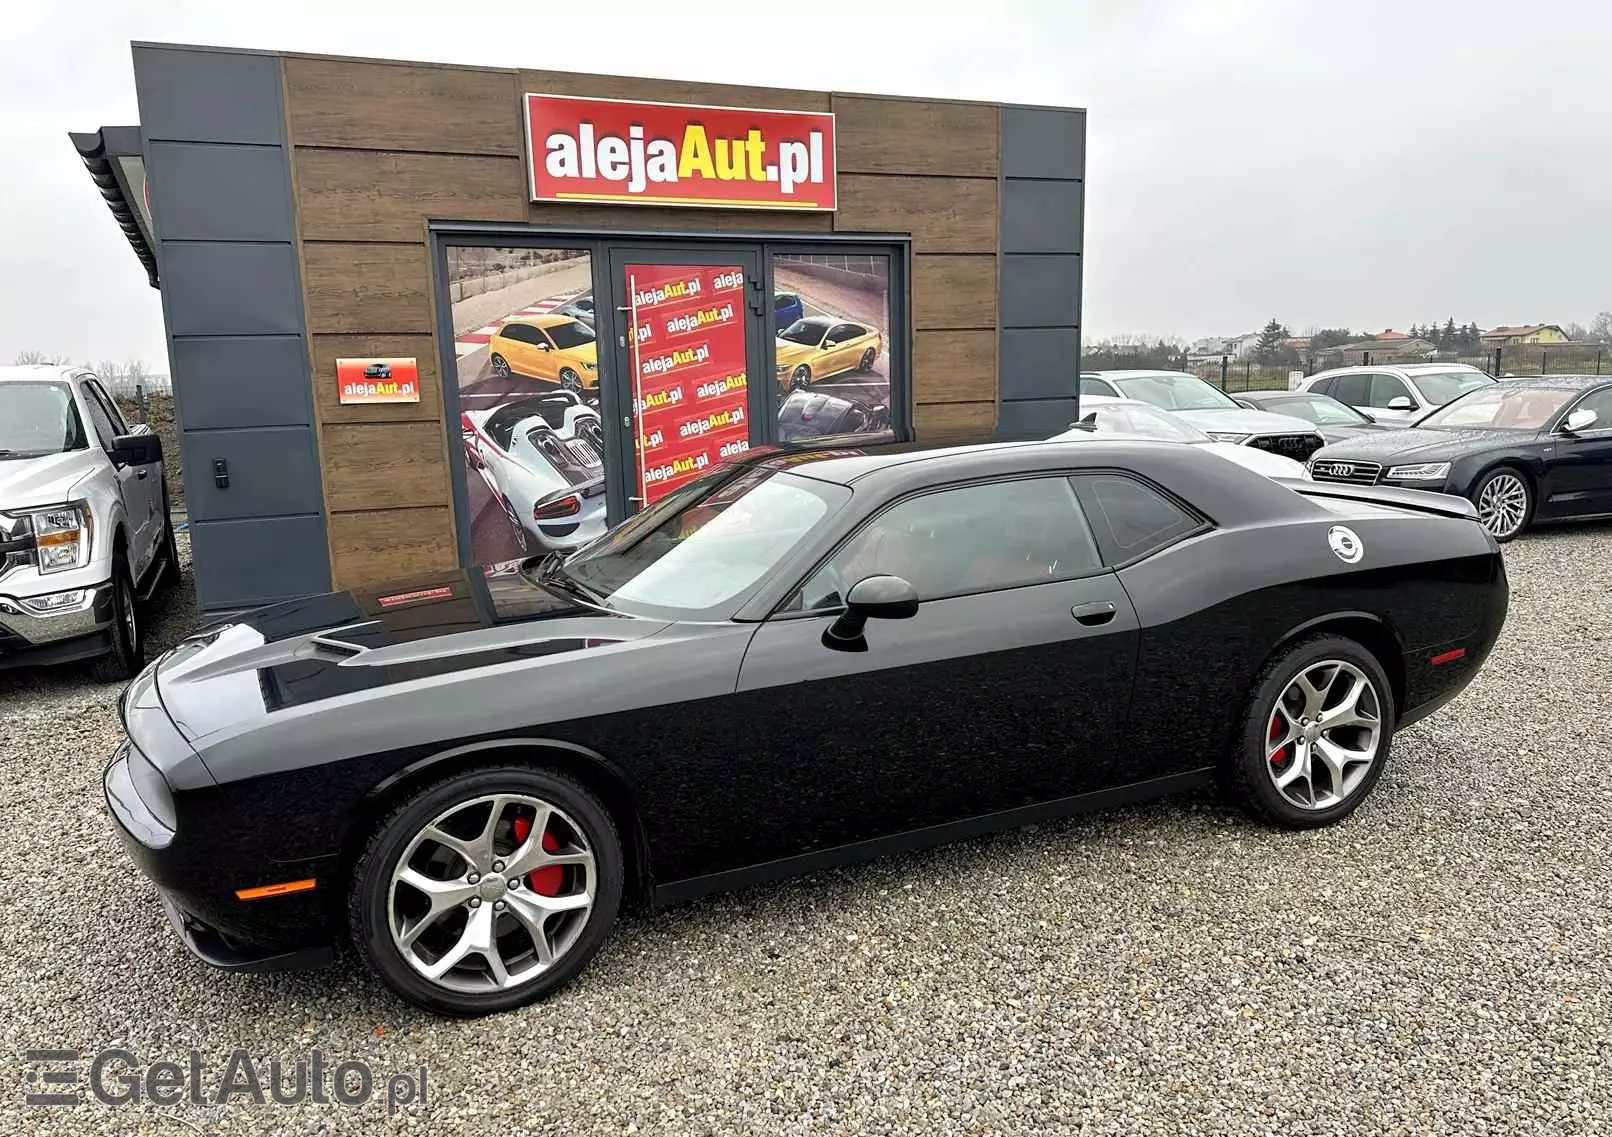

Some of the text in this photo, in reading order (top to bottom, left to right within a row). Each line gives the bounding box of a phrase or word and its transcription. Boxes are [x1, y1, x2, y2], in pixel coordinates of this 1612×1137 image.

[545, 123, 824, 194] alejaAut.pl
[634, 278, 701, 306] alejaAut.pl
[713, 272, 744, 289] aleja
[666, 304, 734, 333] alejaAut.pl
[642, 344, 709, 374] alejaAut.pl
[343, 381, 415, 397] alejaAut.pl
[679, 407, 745, 437] alejaAut.pl
[644, 452, 709, 482] alejaAut.pl
